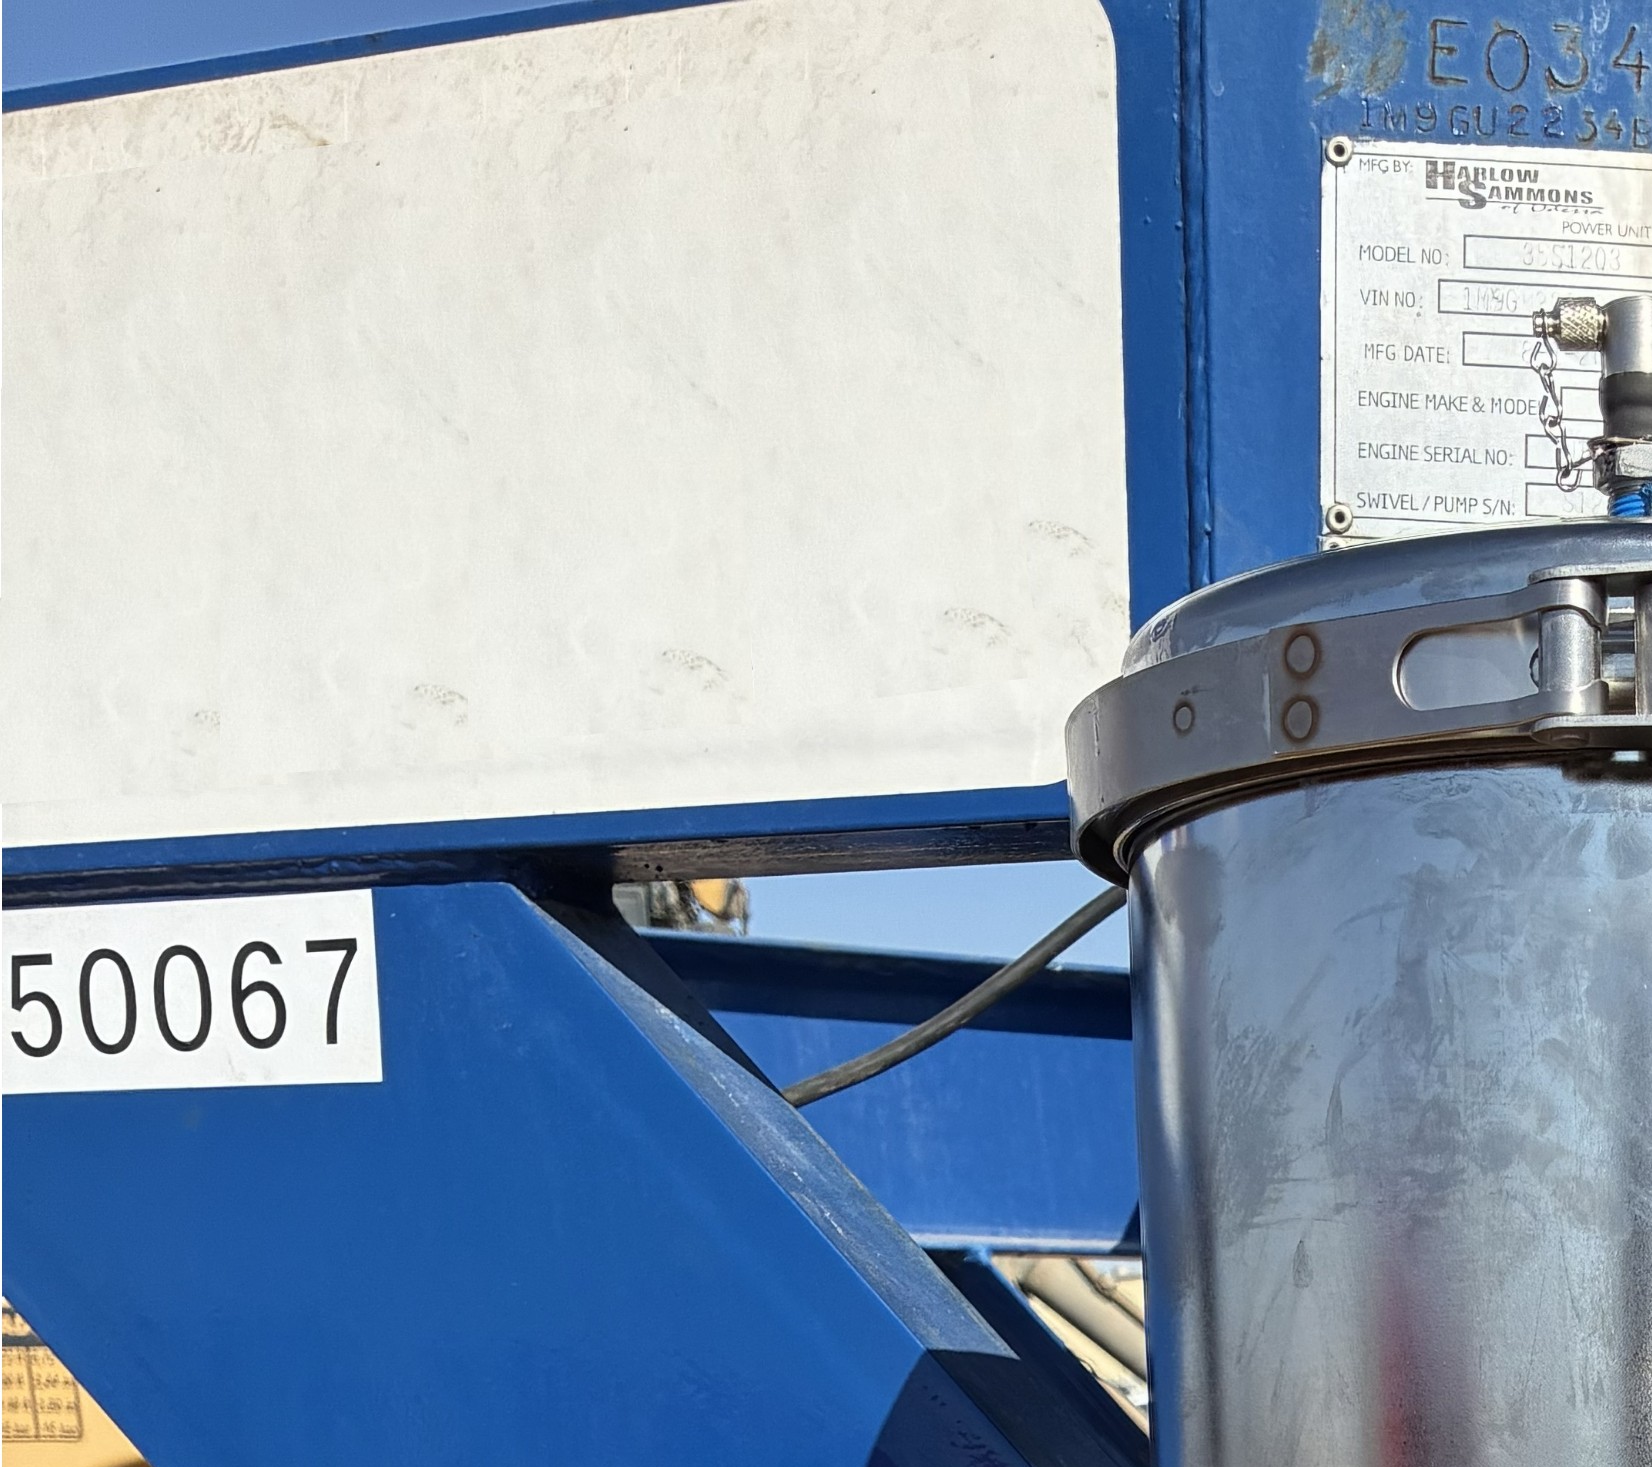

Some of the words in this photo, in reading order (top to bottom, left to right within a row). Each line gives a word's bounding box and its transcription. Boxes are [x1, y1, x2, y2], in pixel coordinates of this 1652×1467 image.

[1359, 158, 1389, 174] MFG
[1425, 159, 1540, 190] HARLOW
[1457, 180, 1594, 210] SAMMONS
[1562, 220, 1613, 237] POWER
[1617, 225, 1651, 240] UNIT
[1358, 244, 1416, 264] MODEL
[1421, 246, 1449, 266] NO:
[1359, 288, 1391, 307] VIN
[1394, 291, 1423, 309] NO:
[1364, 343, 1396, 361] MFG
[1403, 345, 1451, 364] DATE:
[1357, 389, 1419, 410] ENGINE
[1424, 393, 1468, 413] MAKE
[1471, 396, 1485, 413] &
[1490, 396, 1543, 416] MODE
[1357, 441, 1419, 461] ENGINE
[1423, 445, 1483, 465] SERIAL
[1484, 449, 1514, 466] NO:
[1356, 491, 1419, 511] SWIVEL
[1433, 496, 1478, 514] PUMP
[1482, 497, 1516, 517] S/N:
[10, 937, 359, 1058] 50067
